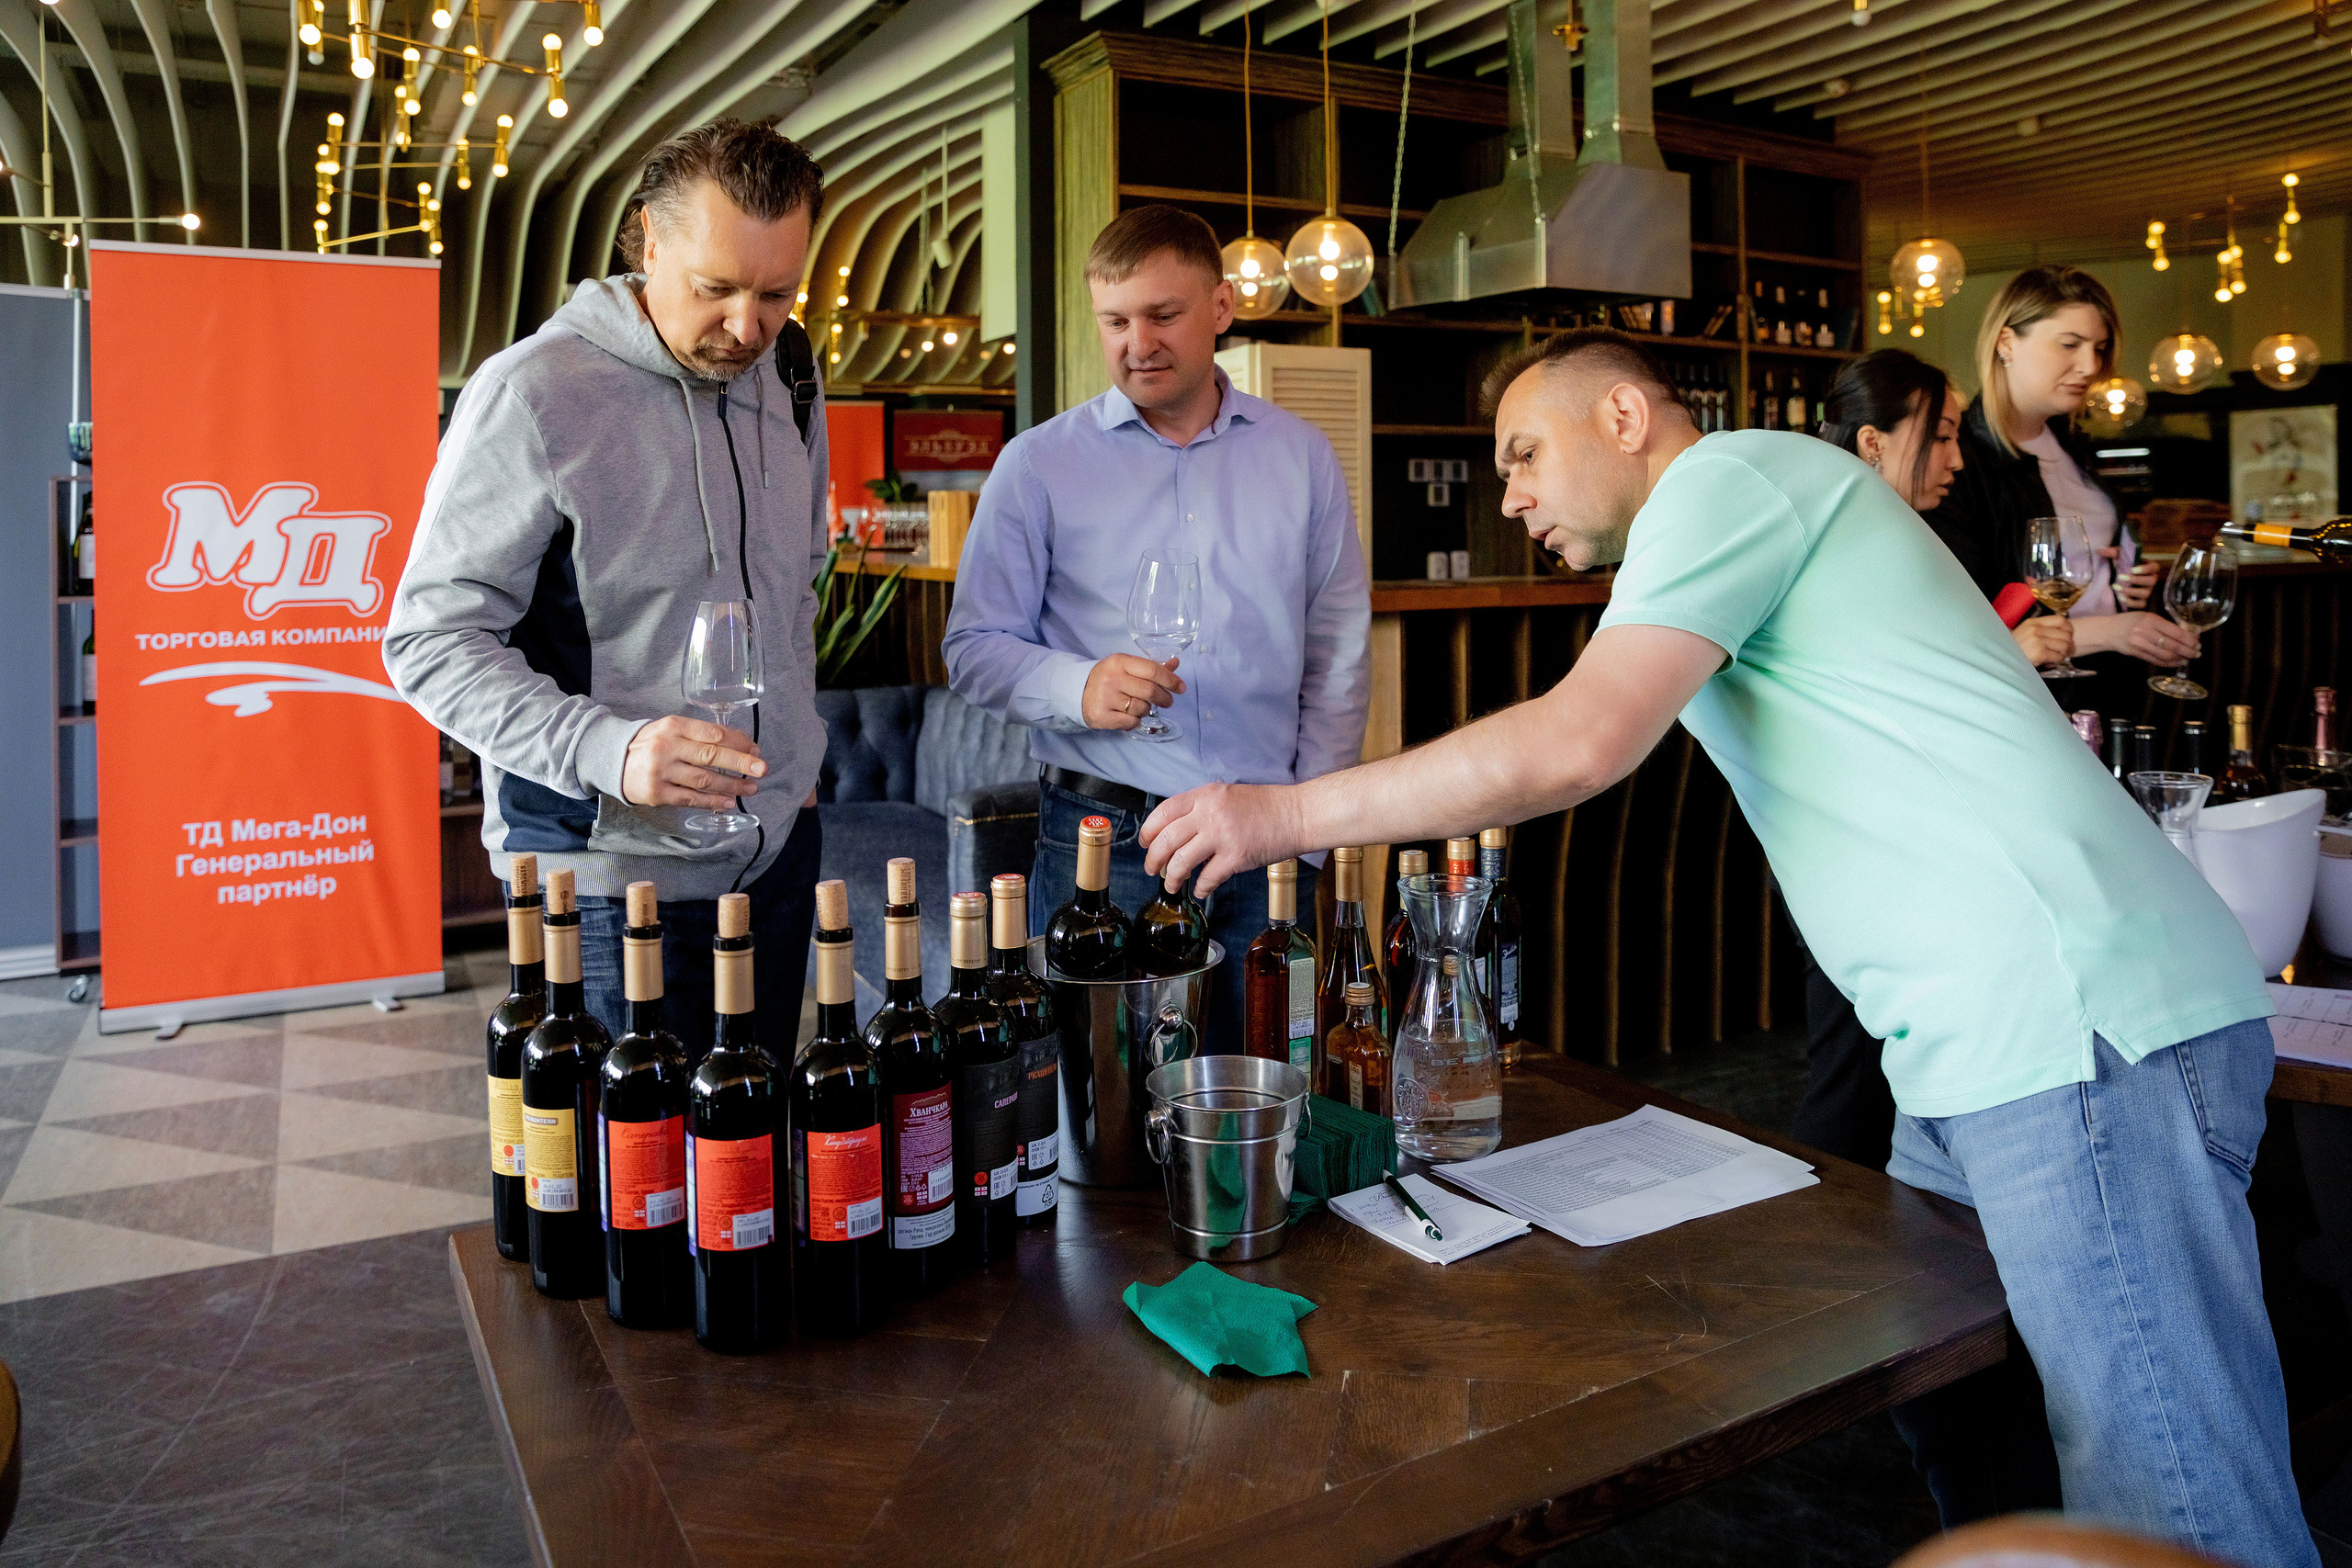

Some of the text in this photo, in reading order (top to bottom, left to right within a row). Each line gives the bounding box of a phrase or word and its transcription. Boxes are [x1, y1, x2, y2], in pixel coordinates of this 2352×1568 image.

[146, 480, 393, 621] МД
[135, 625, 389, 651] ТОРГОВАЯ КОМПАНИ
[182, 812, 368, 849] ТД Мега-Дон
[175, 839, 375, 877] Генеральный
[217, 874, 337, 906] партнёр
